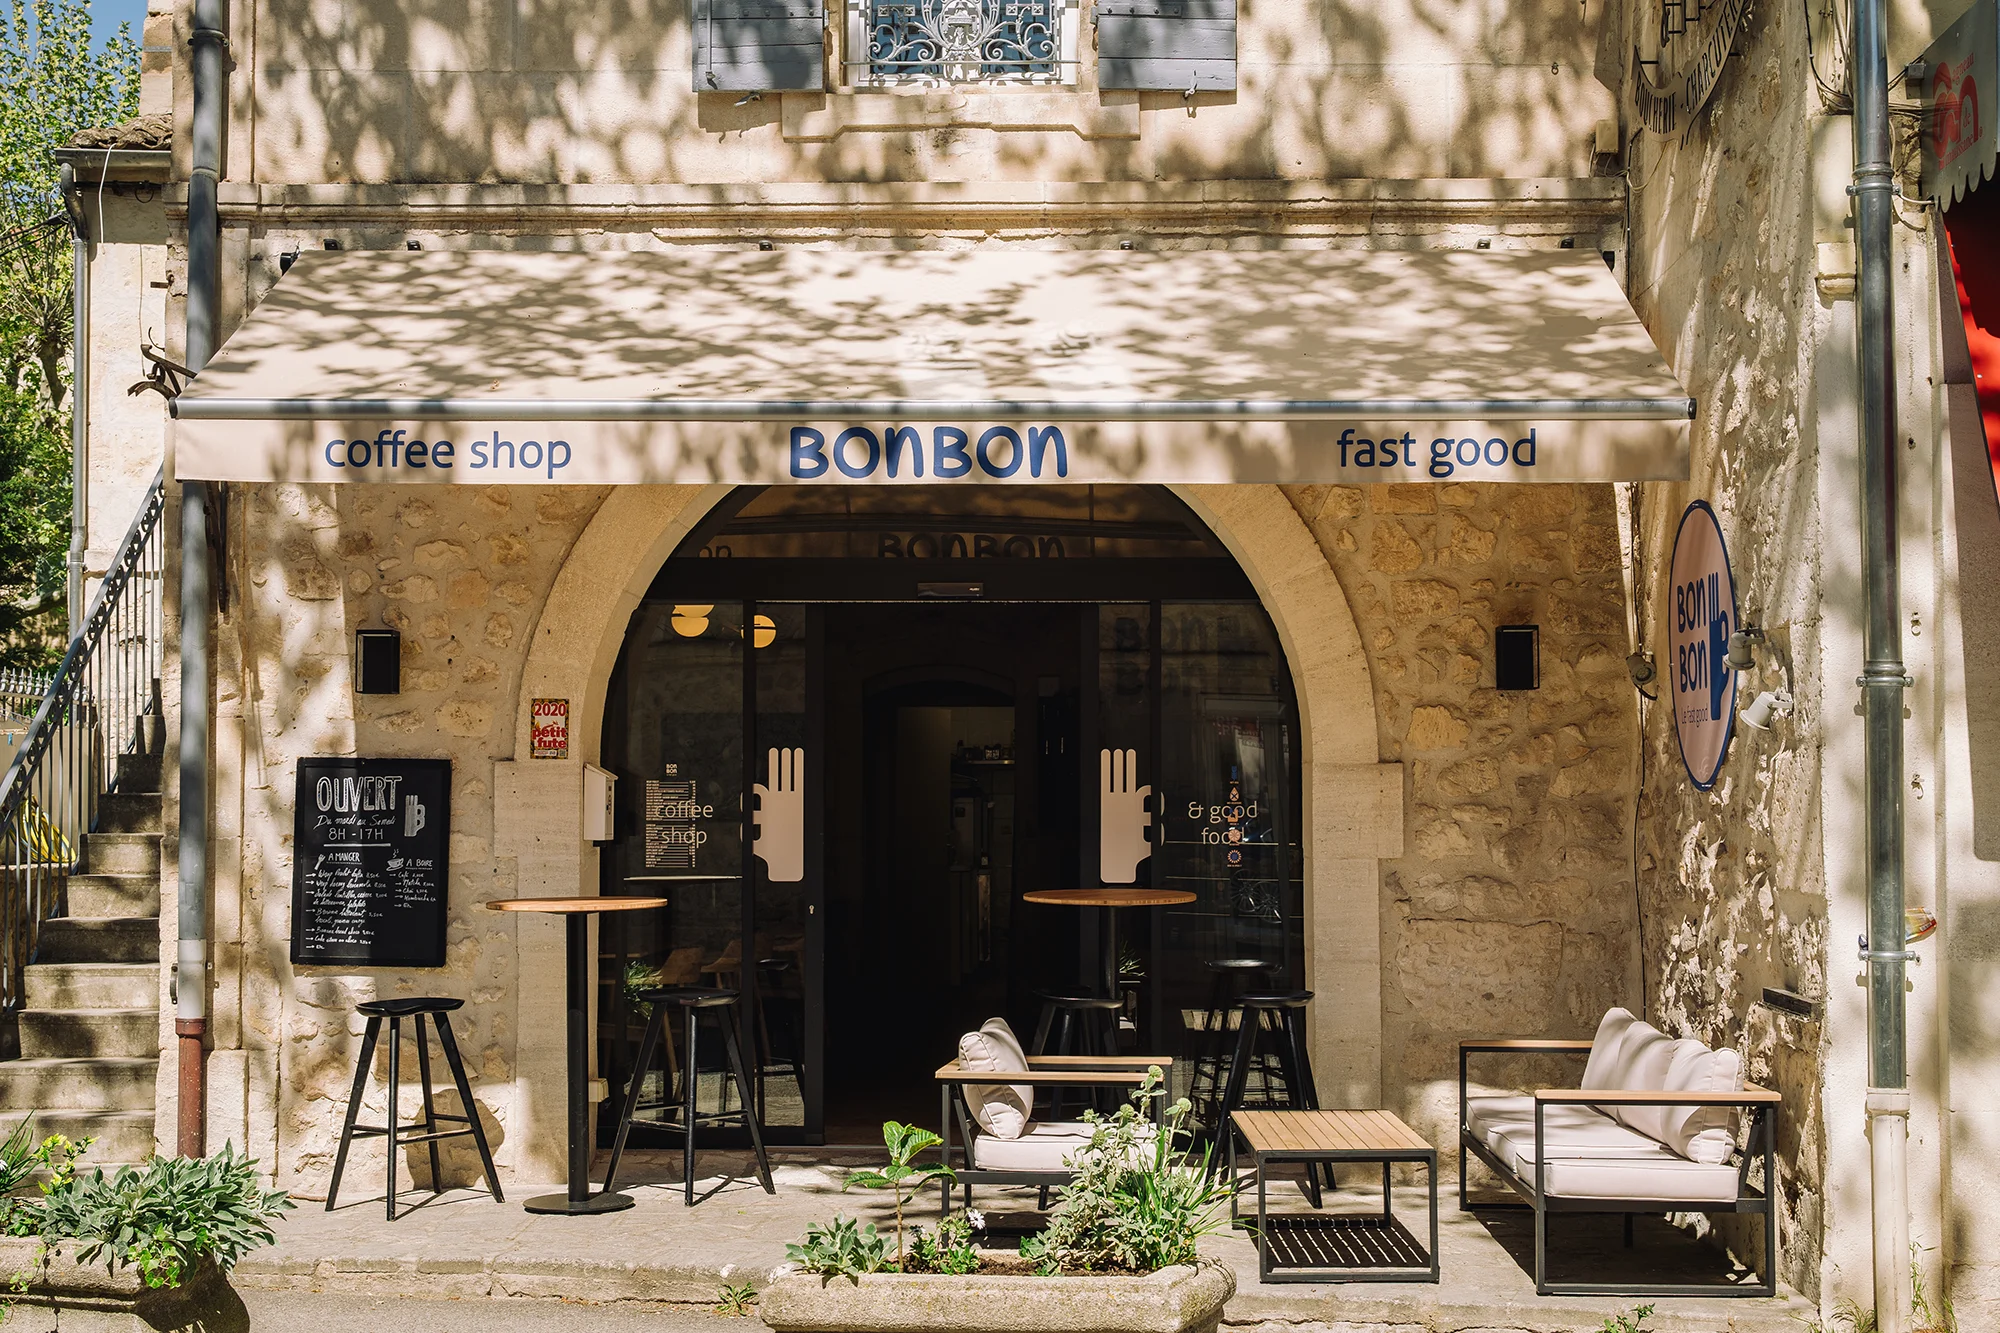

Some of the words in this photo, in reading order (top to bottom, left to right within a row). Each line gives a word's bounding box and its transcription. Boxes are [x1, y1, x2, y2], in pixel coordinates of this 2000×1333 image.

[1634, 70, 1676, 134] BOUCHERIE
[1686, 0, 1741, 115] CHARCUTER
[325, 430, 455, 468] coffee
[470, 431, 572, 479] shop
[1337, 429, 1416, 467] fast
[1429, 428, 1536, 478] good
[534, 702, 567, 716] 2020
[1687, 705, 1697, 723] fast
[1696, 703, 1708, 728] good
[316, 776, 402, 812] OUVERT
[656, 801, 714, 818] coffee
[1188, 801, 1204, 819] &
[1210, 800, 1258, 825] good
[328, 828, 346, 840] 8H
[360, 828, 384, 840] 17H
[661, 826, 707, 848] shop
[335, 851, 360, 862] MANGER
